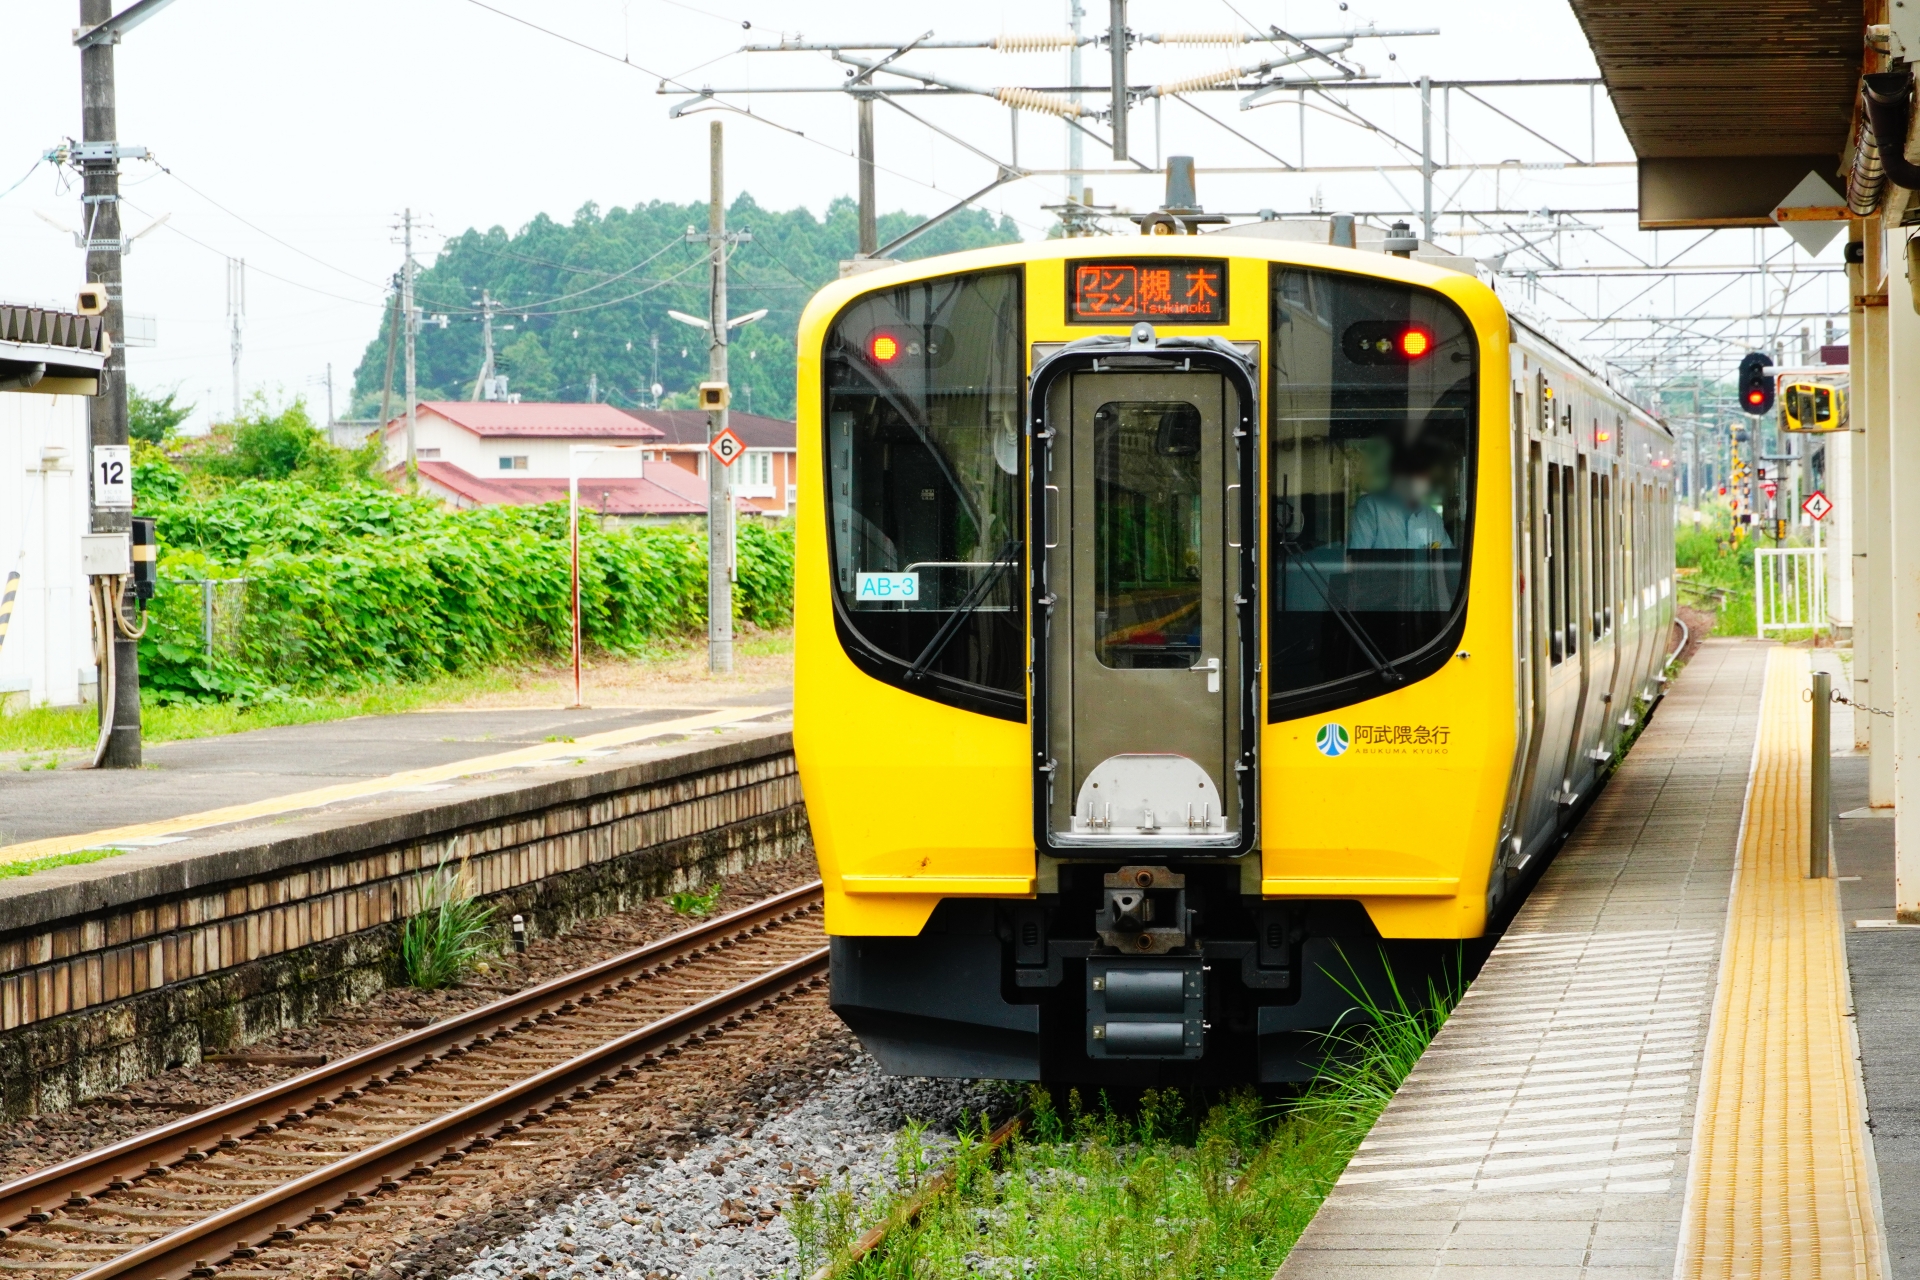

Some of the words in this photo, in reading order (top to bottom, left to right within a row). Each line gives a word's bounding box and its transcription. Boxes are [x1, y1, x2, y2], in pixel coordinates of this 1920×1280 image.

[1081, 269, 1124, 291] ワン
[1139, 268, 1218, 302] 槻木
[1085, 293, 1133, 313] マン
[1140, 301, 1212, 314] Tsukinoki
[721, 438, 733, 456] 6
[101, 461, 124, 485] 12
[1813, 499, 1822, 513] 4
[862, 577, 914, 596] AB-3
[1354, 725, 1451, 745] 阿武隈急行
